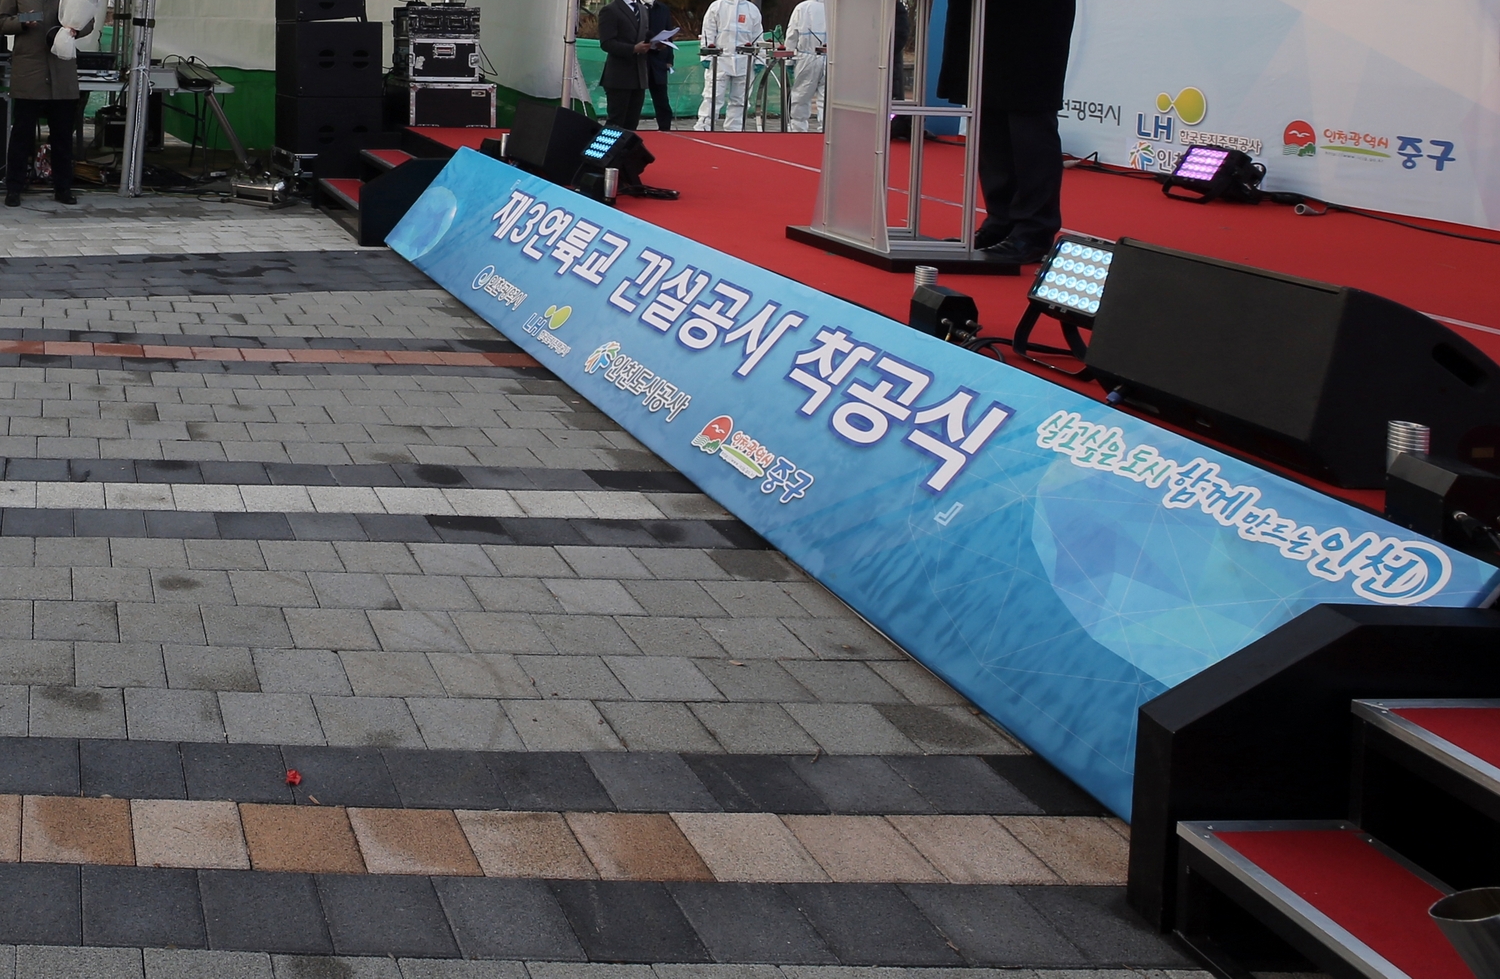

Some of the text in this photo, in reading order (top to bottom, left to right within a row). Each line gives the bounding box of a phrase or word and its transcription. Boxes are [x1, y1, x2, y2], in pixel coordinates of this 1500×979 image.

[1137, 113, 1173, 140] LH
[1323, 128, 1456, 171] 인천광역시 중구
[522, 312, 547, 337] LH
[609, 248, 804, 378] 건설공사
[604, 354, 691, 422] 인천도시공사
[761, 457, 813, 502] 중구
[1118, 449, 1172, 483] 도시
[1169, 462, 1254, 521] 함께
[1241, 511, 1312, 555] 만드는
[1315, 532, 1443, 599] 인천
